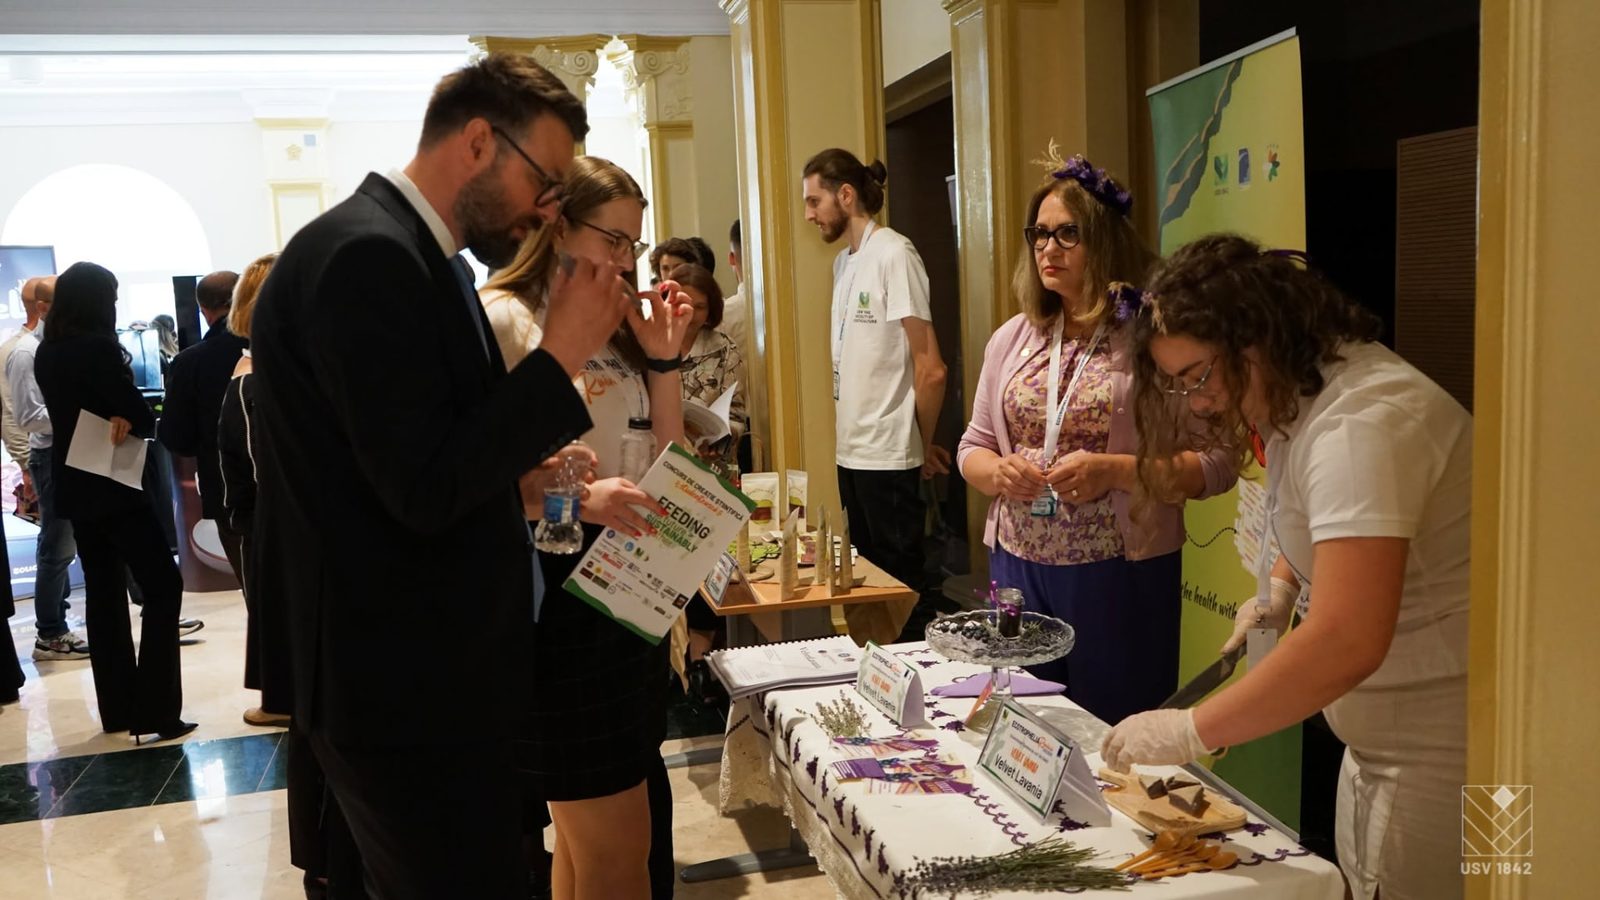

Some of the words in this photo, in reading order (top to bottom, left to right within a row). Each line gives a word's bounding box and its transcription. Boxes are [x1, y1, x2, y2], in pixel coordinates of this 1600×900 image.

[662, 461, 688, 480] CONCURS
[686, 476, 695, 485] DE
[646, 513, 698, 553] SUSTAINABLY
[657, 495, 710, 539] FEEDING
[1180, 580, 1193, 600] the
[1194, 586, 1218, 612] health
[1219, 601, 1238, 620] with
[994, 753, 1016, 779] Velvet
[1015, 770, 1043, 800] Lavania
